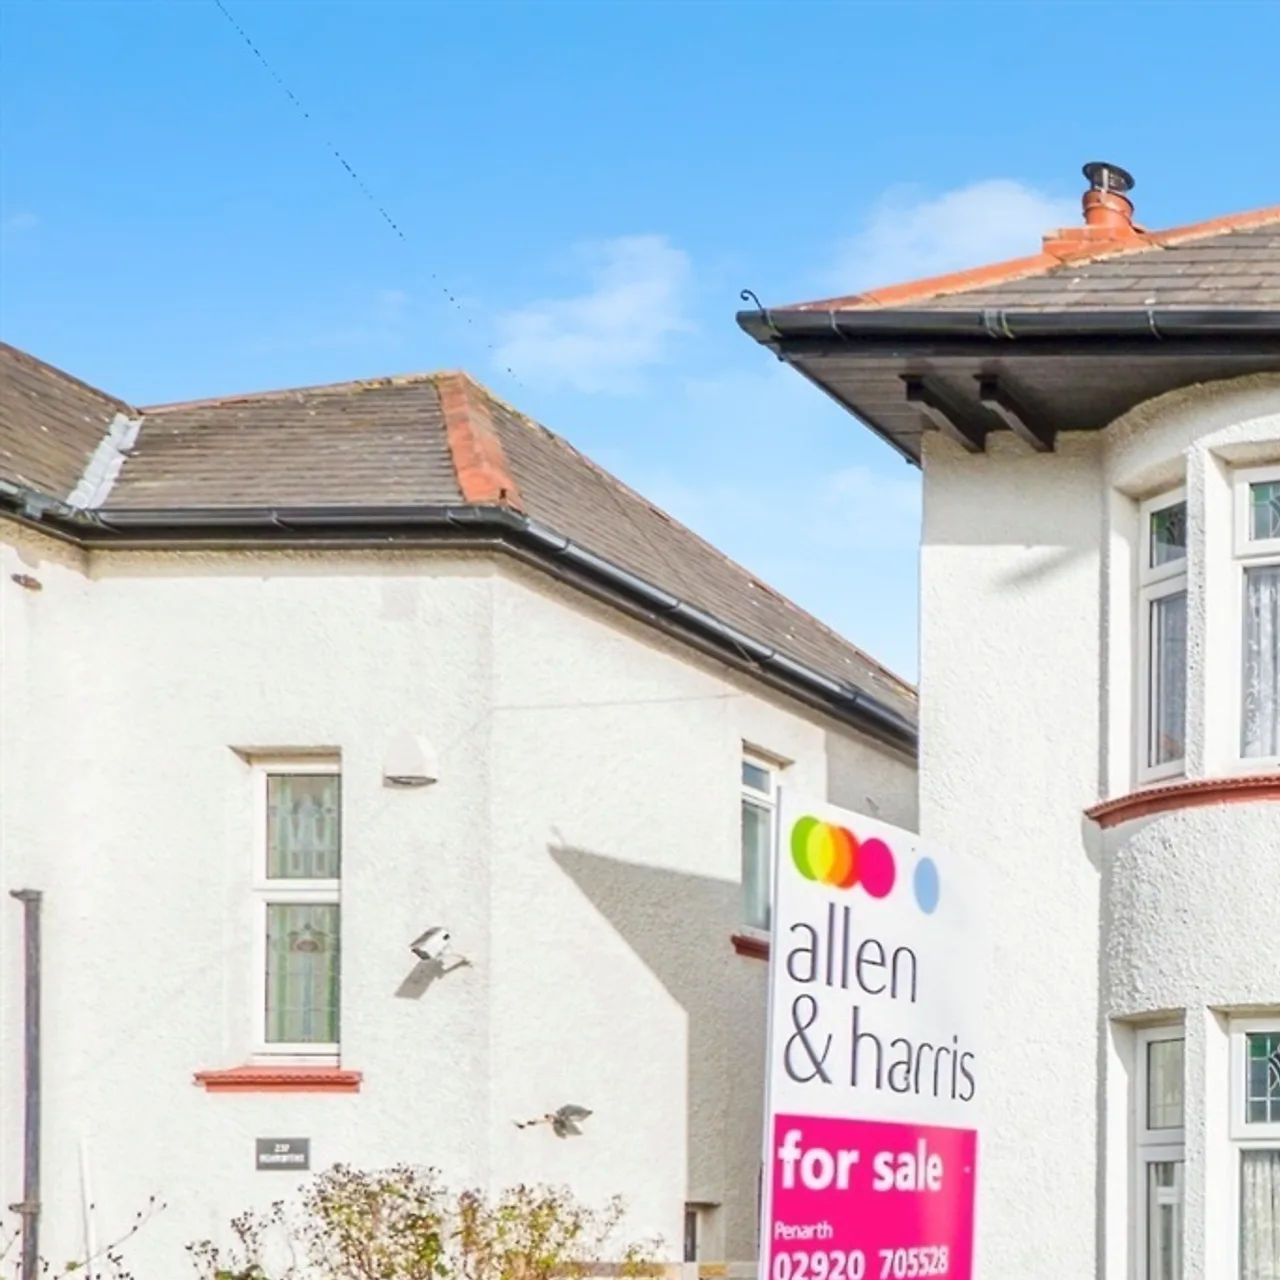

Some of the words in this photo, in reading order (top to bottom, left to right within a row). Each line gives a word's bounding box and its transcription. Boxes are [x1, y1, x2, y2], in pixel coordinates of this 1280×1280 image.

[786, 902, 917, 1003] allen
[784, 994, 833, 1084] &
[850, 1005, 975, 1101] harris
[778, 1130, 860, 1190] for
[872, 1138, 944, 1191] sale
[774, 1221, 833, 1240] Penarth
[878, 1245, 949, 1280] 705528
